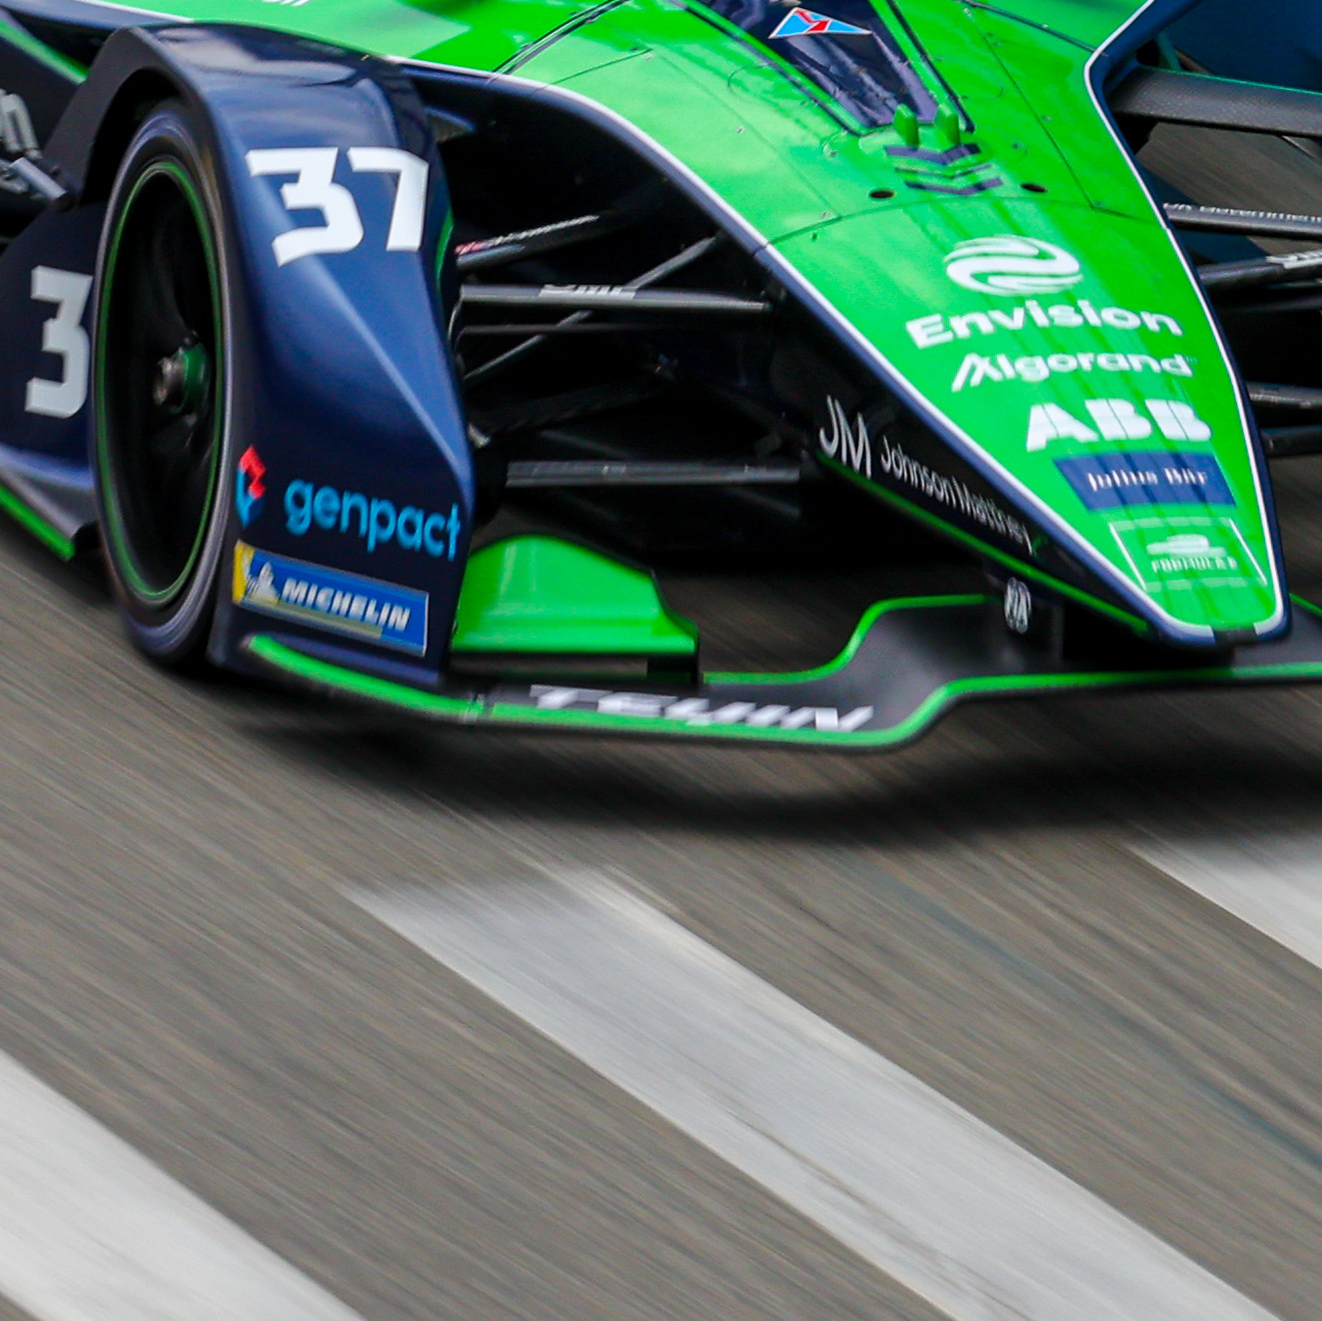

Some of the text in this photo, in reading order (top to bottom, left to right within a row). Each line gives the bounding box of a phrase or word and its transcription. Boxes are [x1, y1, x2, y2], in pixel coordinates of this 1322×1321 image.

[244, 146, 430, 268] 37
[906, 299, 1183, 350] Envision
[951, 352, 1194, 392] Algorand
[1026, 398, 1212, 453] ABB
[284, 478, 461, 563] genpact
[281, 576, 412, 633] MICHELIN
